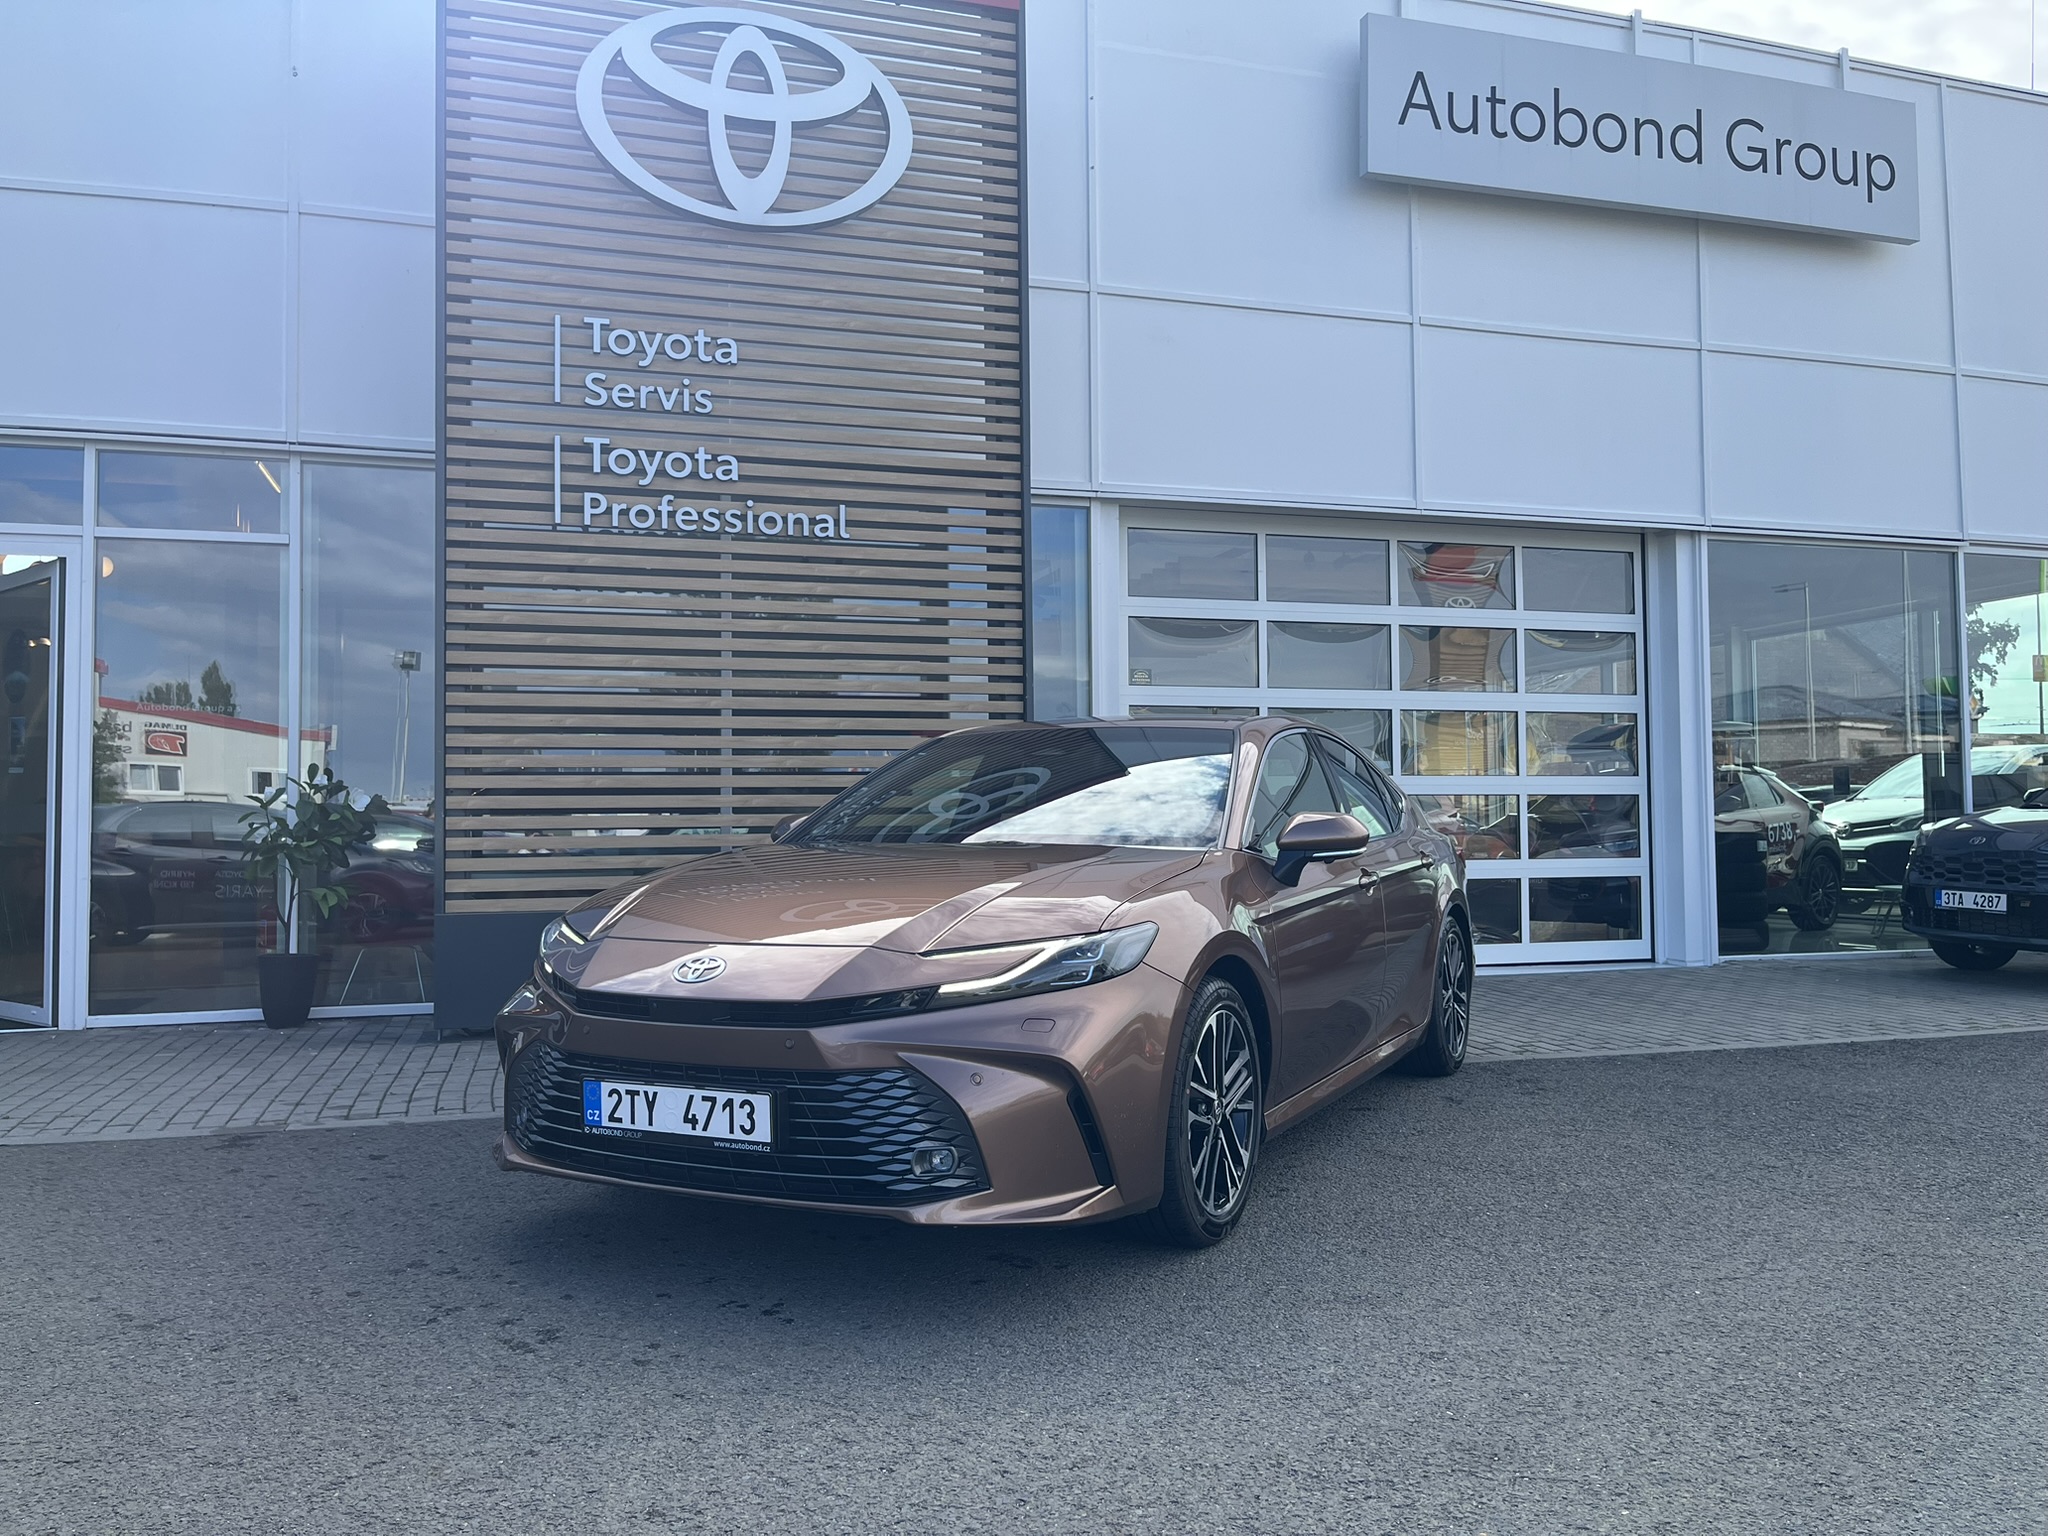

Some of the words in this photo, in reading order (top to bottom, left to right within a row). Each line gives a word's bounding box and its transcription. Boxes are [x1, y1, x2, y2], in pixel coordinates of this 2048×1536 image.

[1398, 70, 1704, 166] Autobond
[1725, 117, 1897, 204] Group
[583, 316, 739, 368] Toyota
[583, 372, 714, 414] Servis
[583, 436, 739, 487] Toyota
[583, 491, 850, 540] Professional
[1944, 892, 1964, 906] 3TA
[1973, 894, 2002, 909] 4287
[586, 1109, 600, 1121] CZ
[591, 1127, 623, 1138] AUTOBOND
[623, 1130, 643, 1139] GROUP
[607, 1088, 659, 1127] 2TY
[682, 1094, 756, 1136] 4713
[713, 1139, 771, 1152] www.autobond.cz
